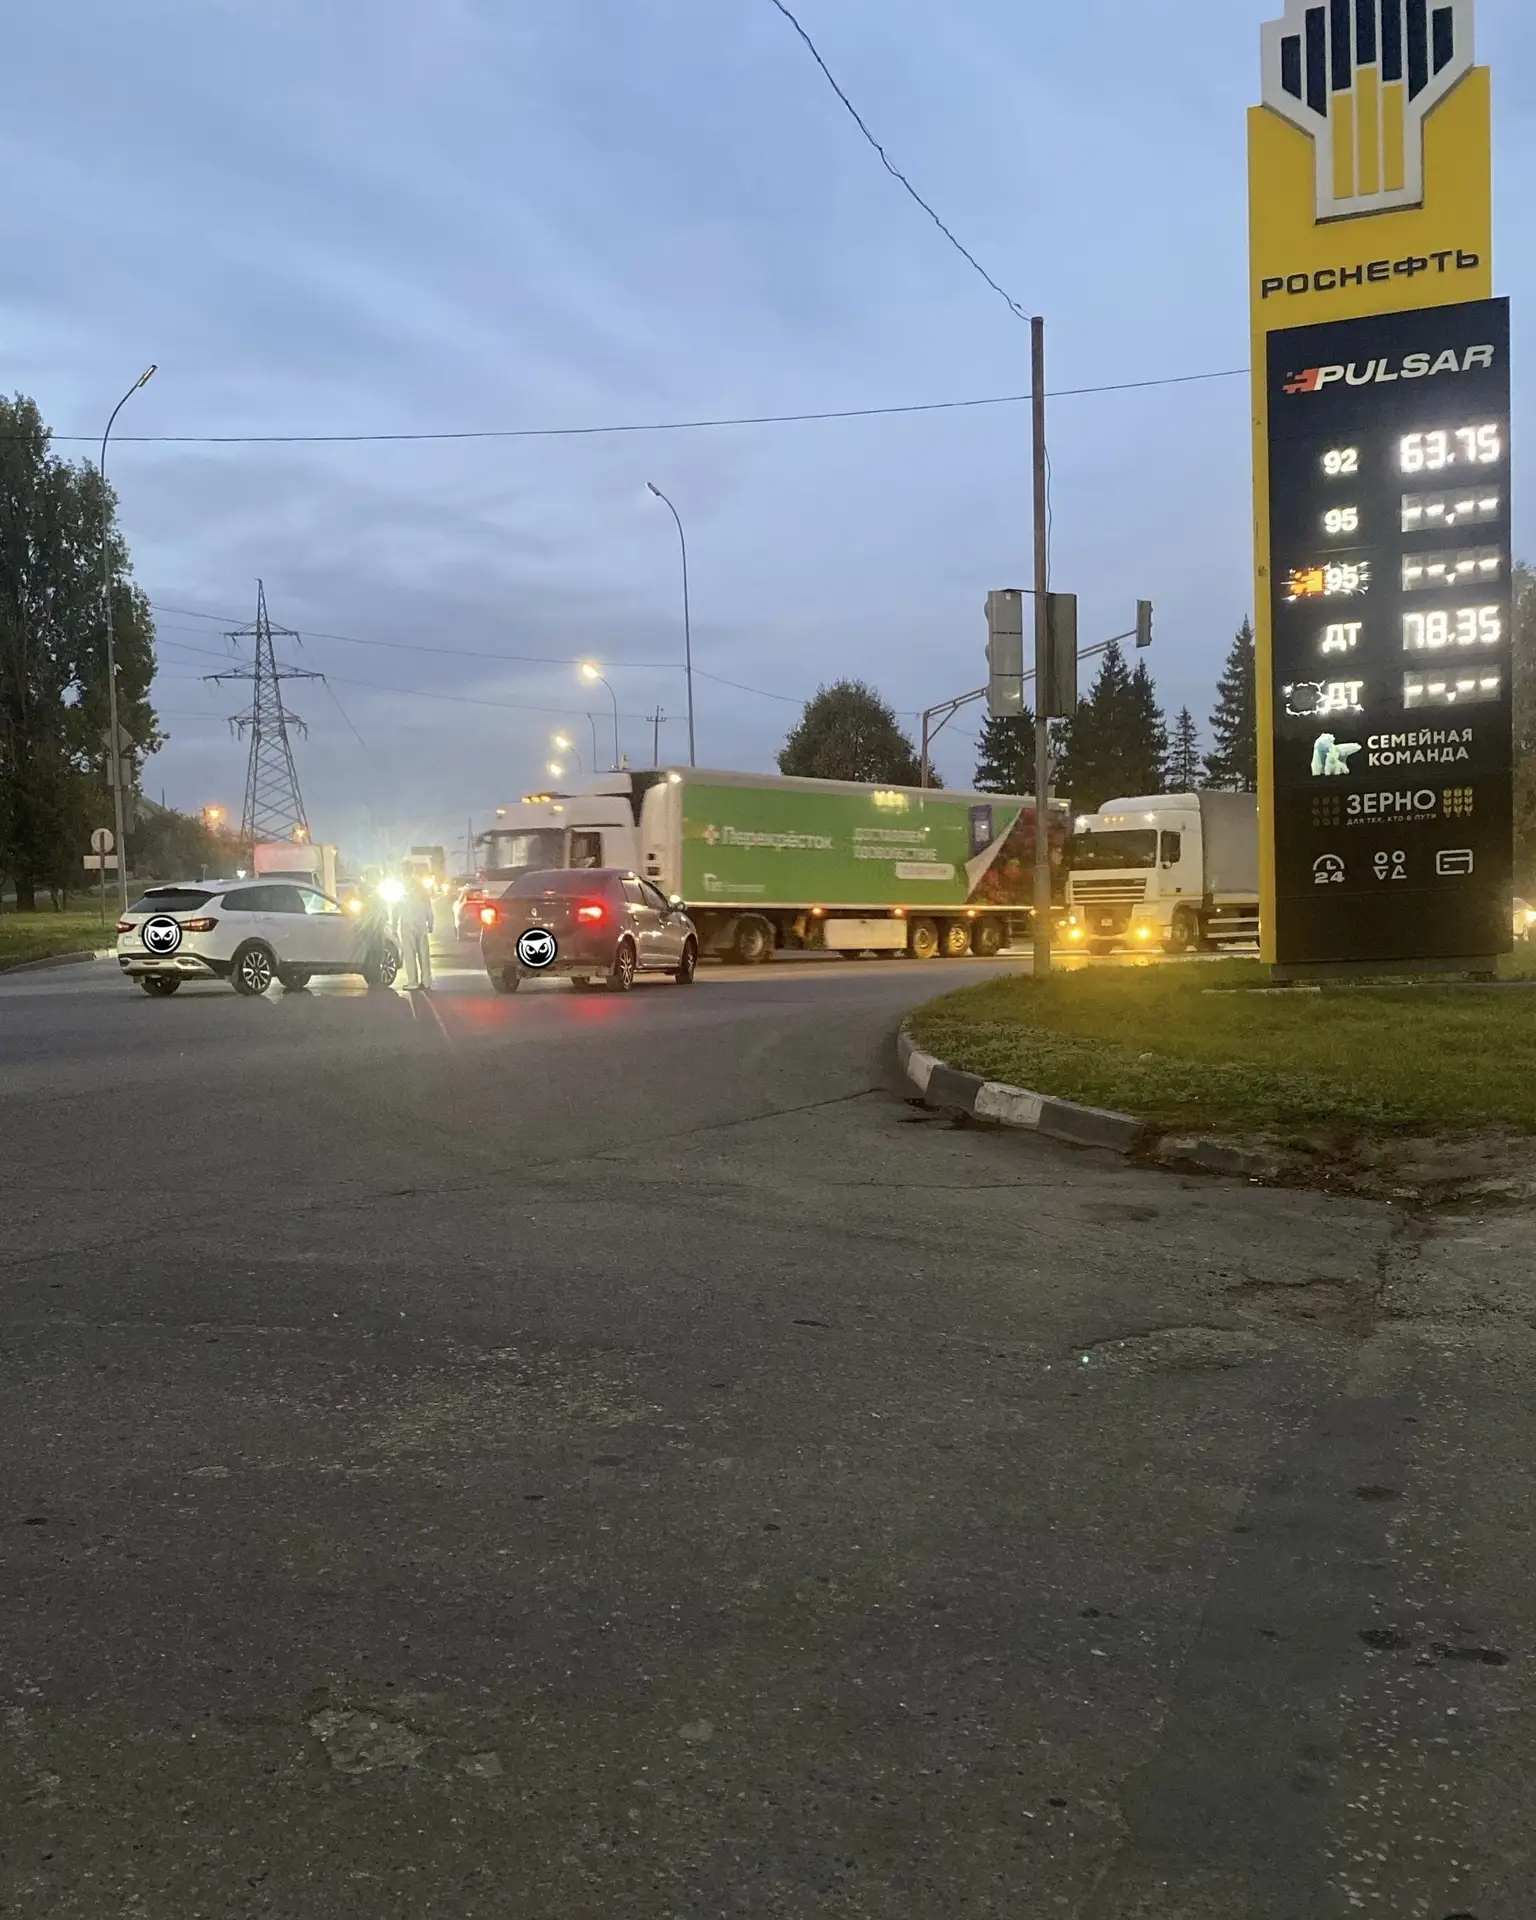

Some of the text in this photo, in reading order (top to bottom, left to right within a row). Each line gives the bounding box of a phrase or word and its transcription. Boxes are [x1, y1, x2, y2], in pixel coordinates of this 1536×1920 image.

[1261, 249, 1480, 299] РОСНЕФТЬ
[1314, 344, 1495, 391] PULSAR
[1323, 448, 1359, 475] 92
[1324, 507, 1359, 534] 95
[1325, 564, 1360, 591] 95
[1322, 621, 1363, 653] ДТ
[1325, 680, 1364, 710] ДТ
[1367, 728, 1473, 749] СЕМЕЙНАЯ
[1368, 746, 1469, 767] КОМАНДА
[1346, 789, 1436, 815] ЗЕРНО
[1314, 871, 1345, 884] 24
